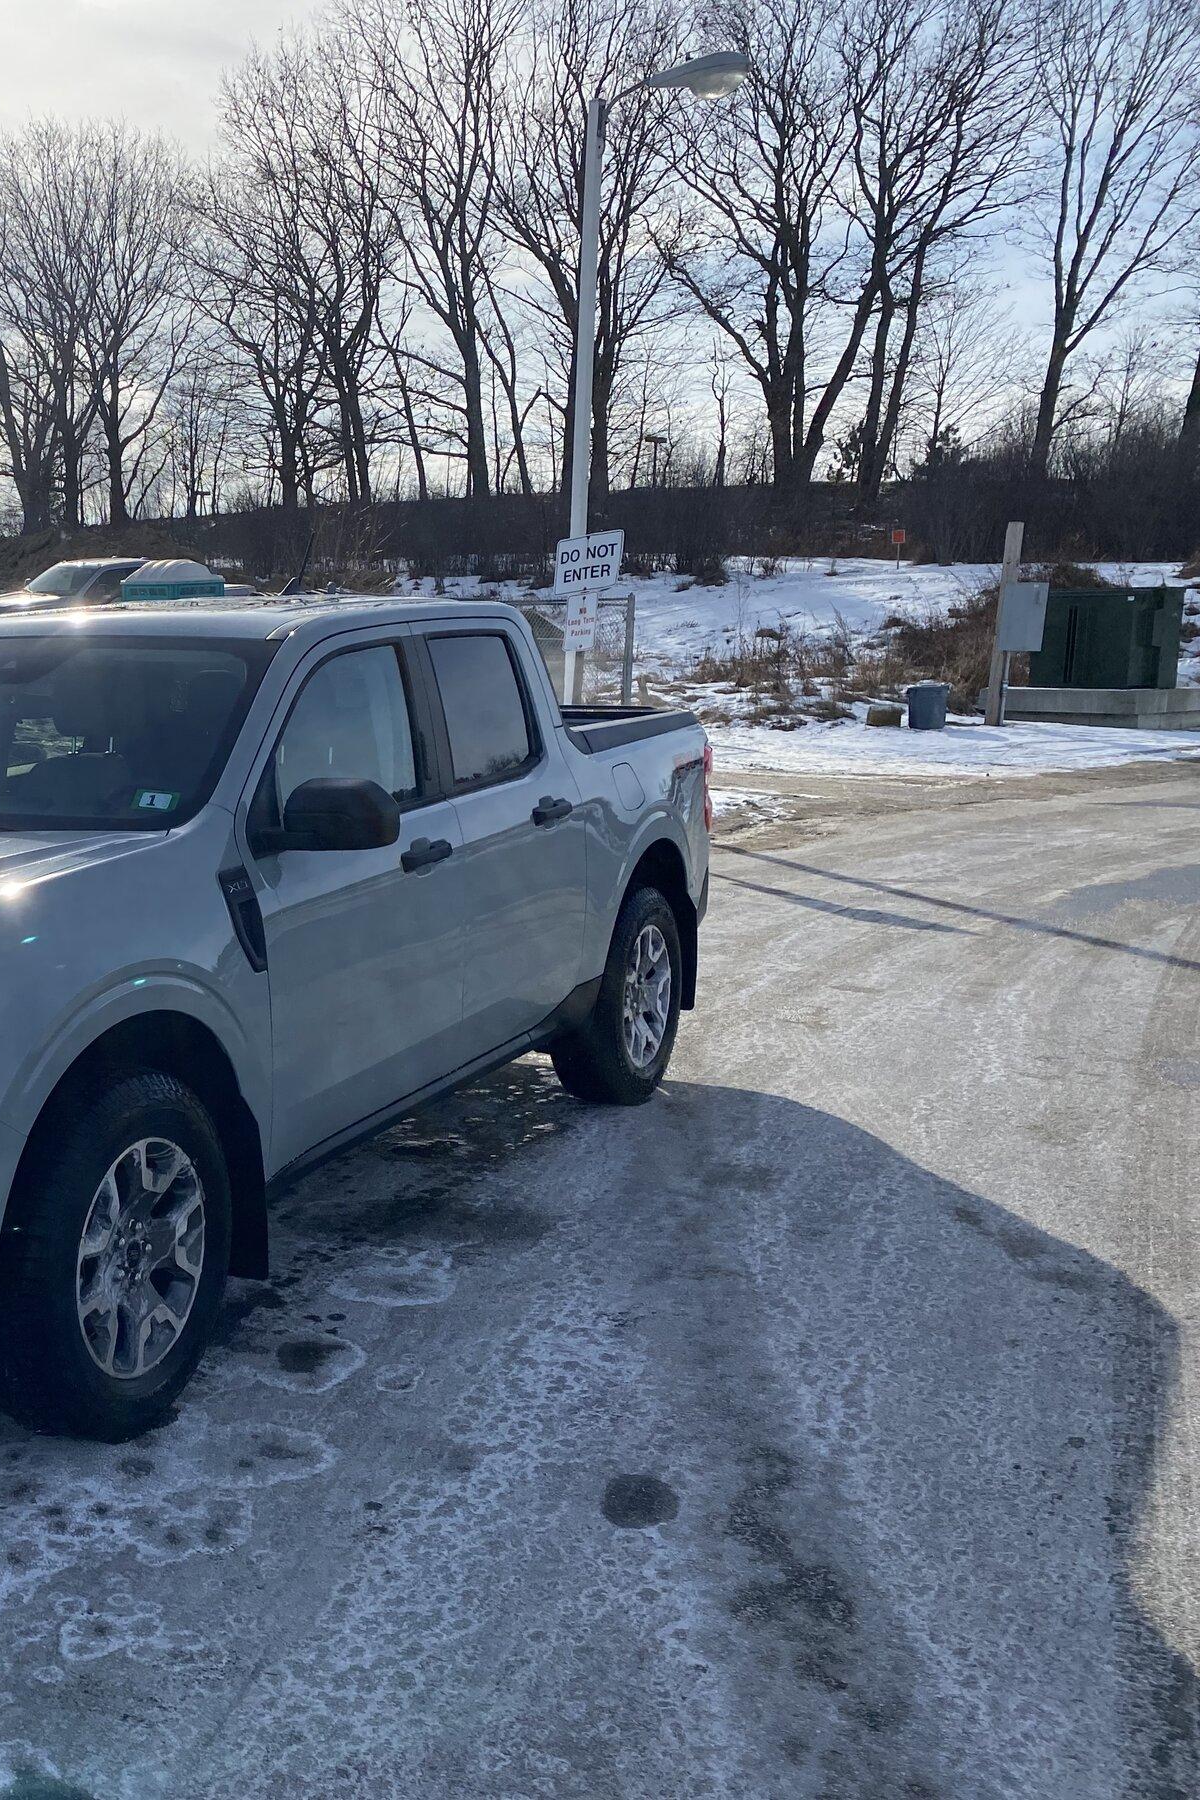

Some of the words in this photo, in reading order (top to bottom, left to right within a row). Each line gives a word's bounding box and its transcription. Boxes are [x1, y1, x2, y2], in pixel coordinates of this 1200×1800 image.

[560, 549, 580, 565] DO
[586, 543, 618, 560] NOT
[563, 564, 611, 583] ENTER
[146, 794, 156, 807] 1
